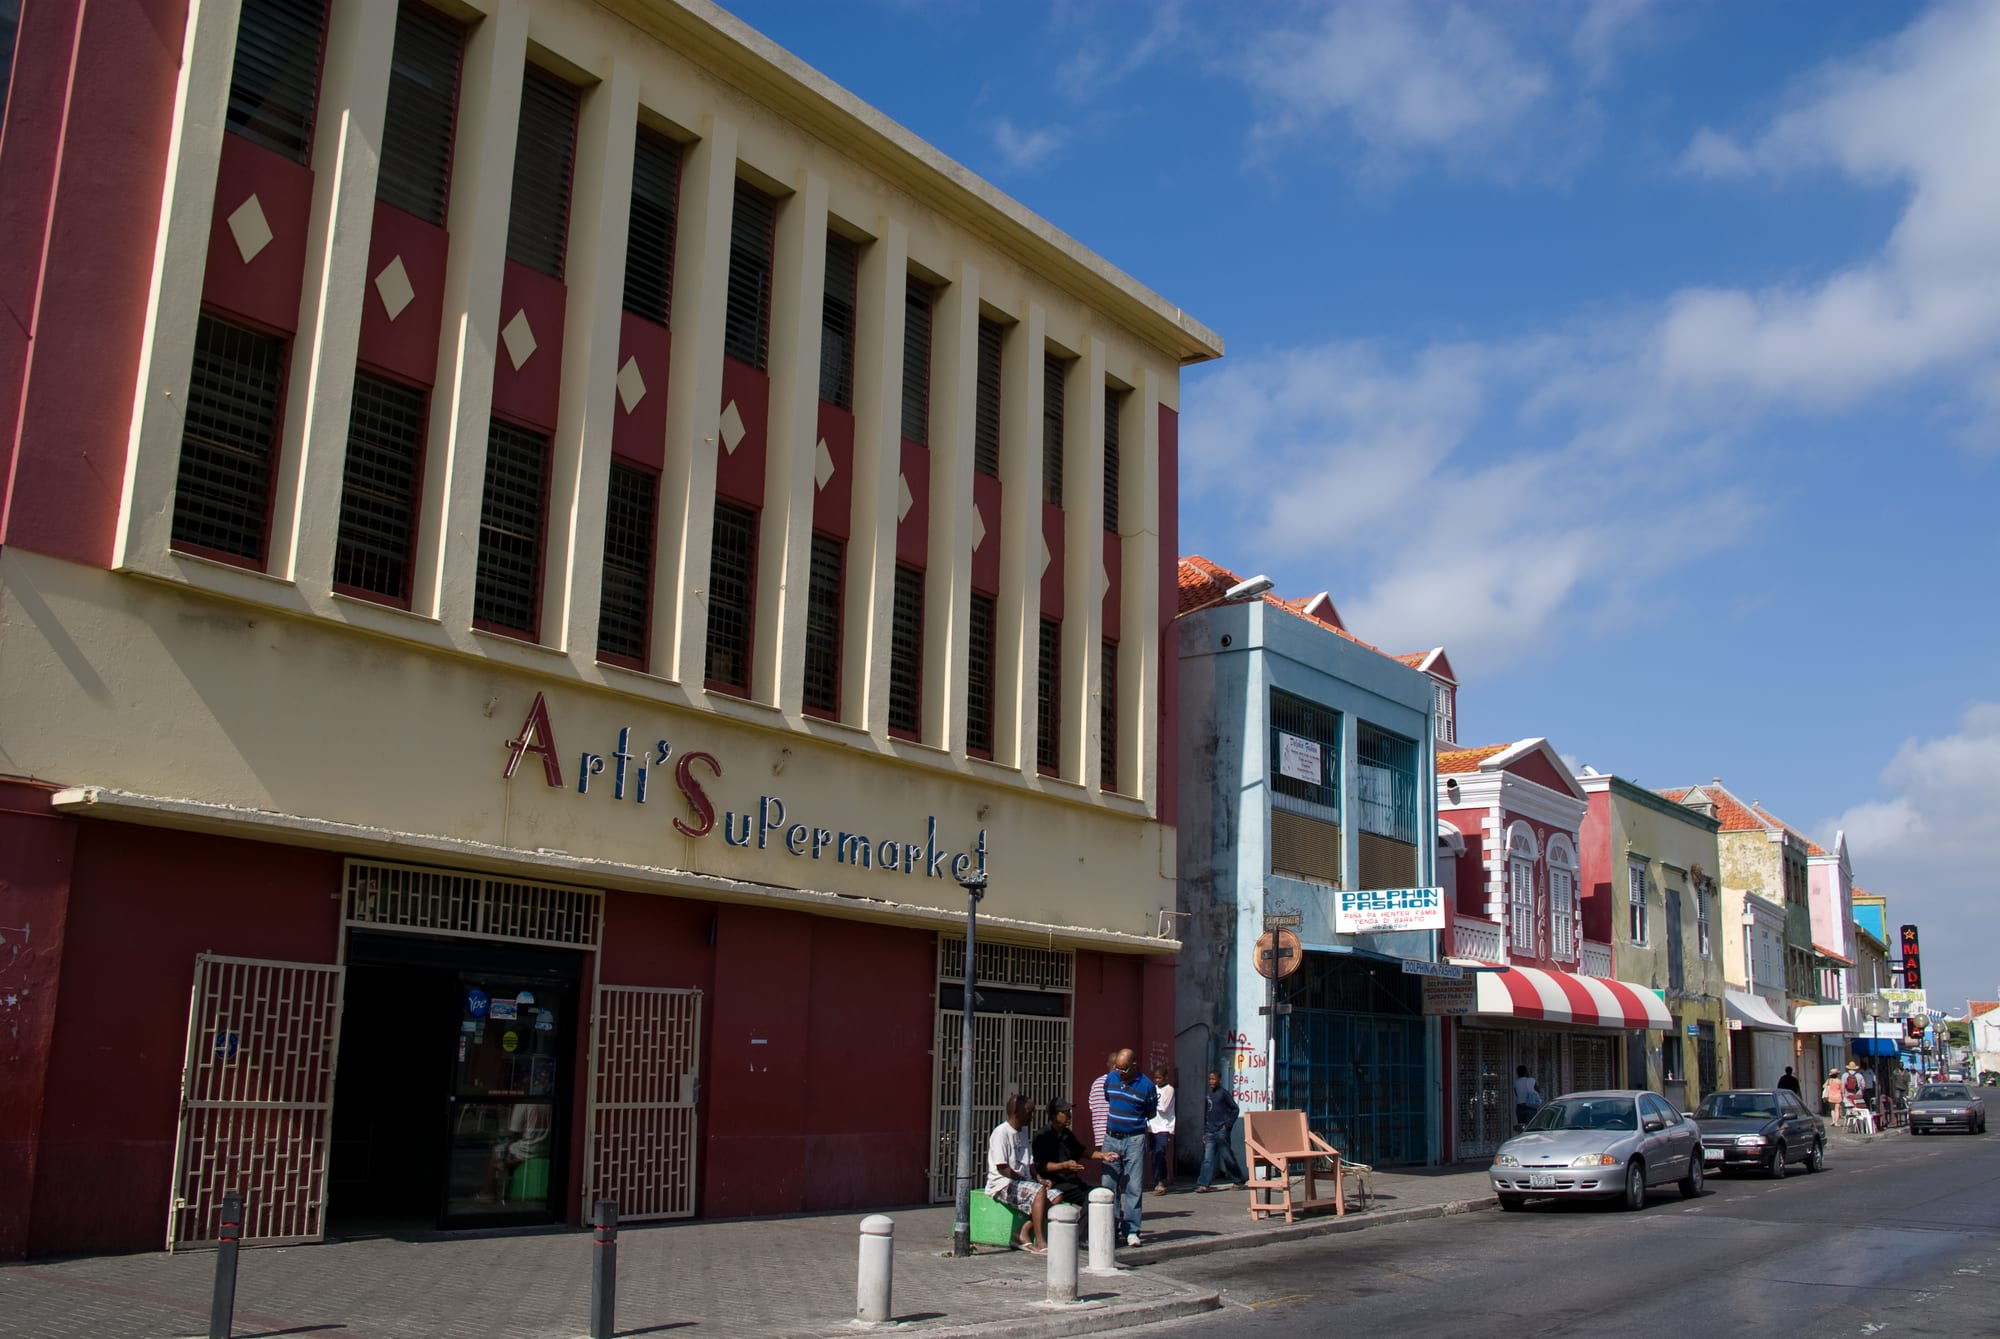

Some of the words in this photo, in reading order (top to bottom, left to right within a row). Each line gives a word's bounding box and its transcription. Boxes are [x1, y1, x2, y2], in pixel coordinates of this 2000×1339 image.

[1342, 889, 1438, 902] DOLPHIN
[1342, 898, 1438, 911] FASHION
[1405, 961, 1429, 974] DOLPHIN
[1439, 965, 1461, 977] FASHION
